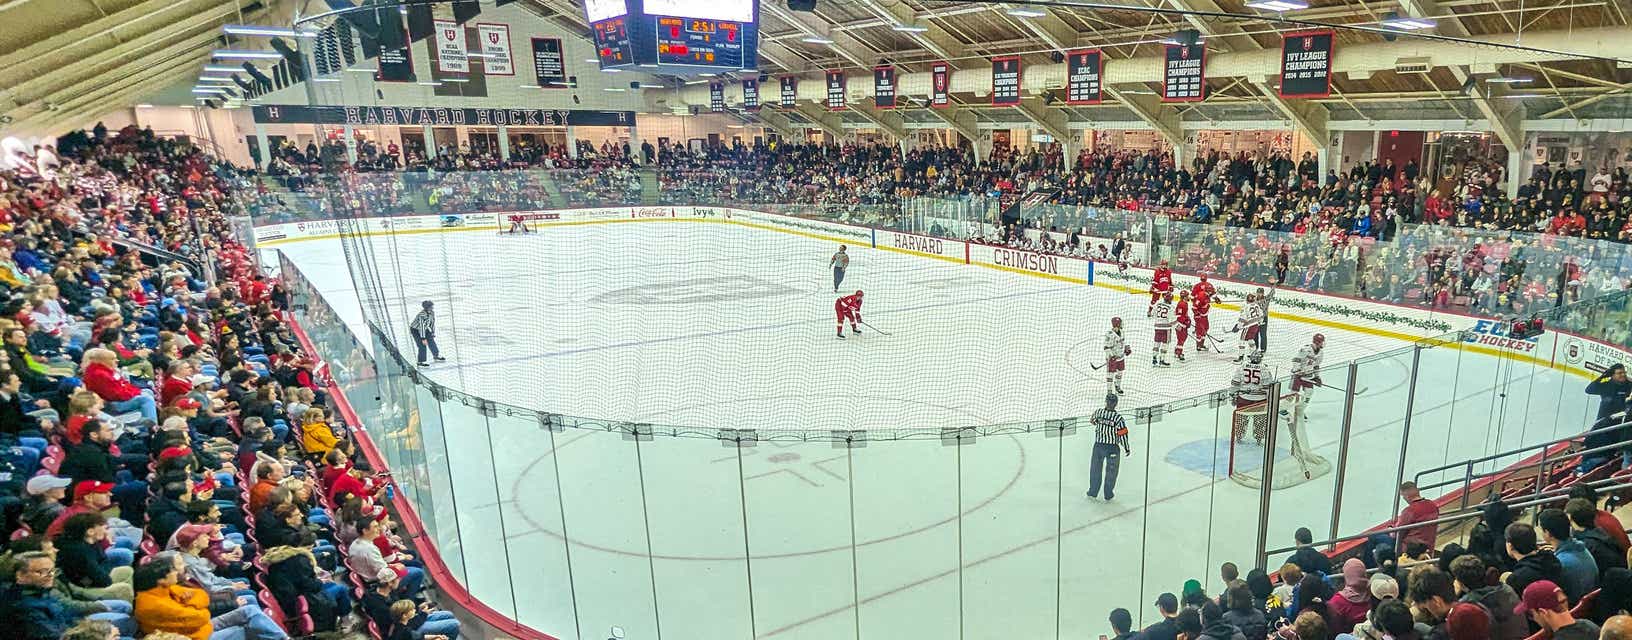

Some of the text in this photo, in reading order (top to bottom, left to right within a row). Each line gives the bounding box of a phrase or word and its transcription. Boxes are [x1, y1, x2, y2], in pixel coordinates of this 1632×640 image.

[692, 20, 715, 32] 2:51
[1286, 51, 1327, 62] IVY LEAGUE
[1168, 59, 1201, 68] IVY LEAGUE
[1285, 60, 1327, 71] CHAMPIONS
[1070, 73, 1099, 82] CHAMPIONS
[1168, 67, 1201, 77] CHAMPIONS
[268, 106, 627, 126] H HARVARD HOCKEY H
[692, 207, 707, 218] Ivy
[894, 233, 1058, 274] HARVARD CRIMSON
[1156, 305, 1169, 319] 22
[1478, 334, 1536, 353] HOCKEY
[1589, 342, 1624, 361] HARVARD
[1243, 368, 1261, 385] 35
